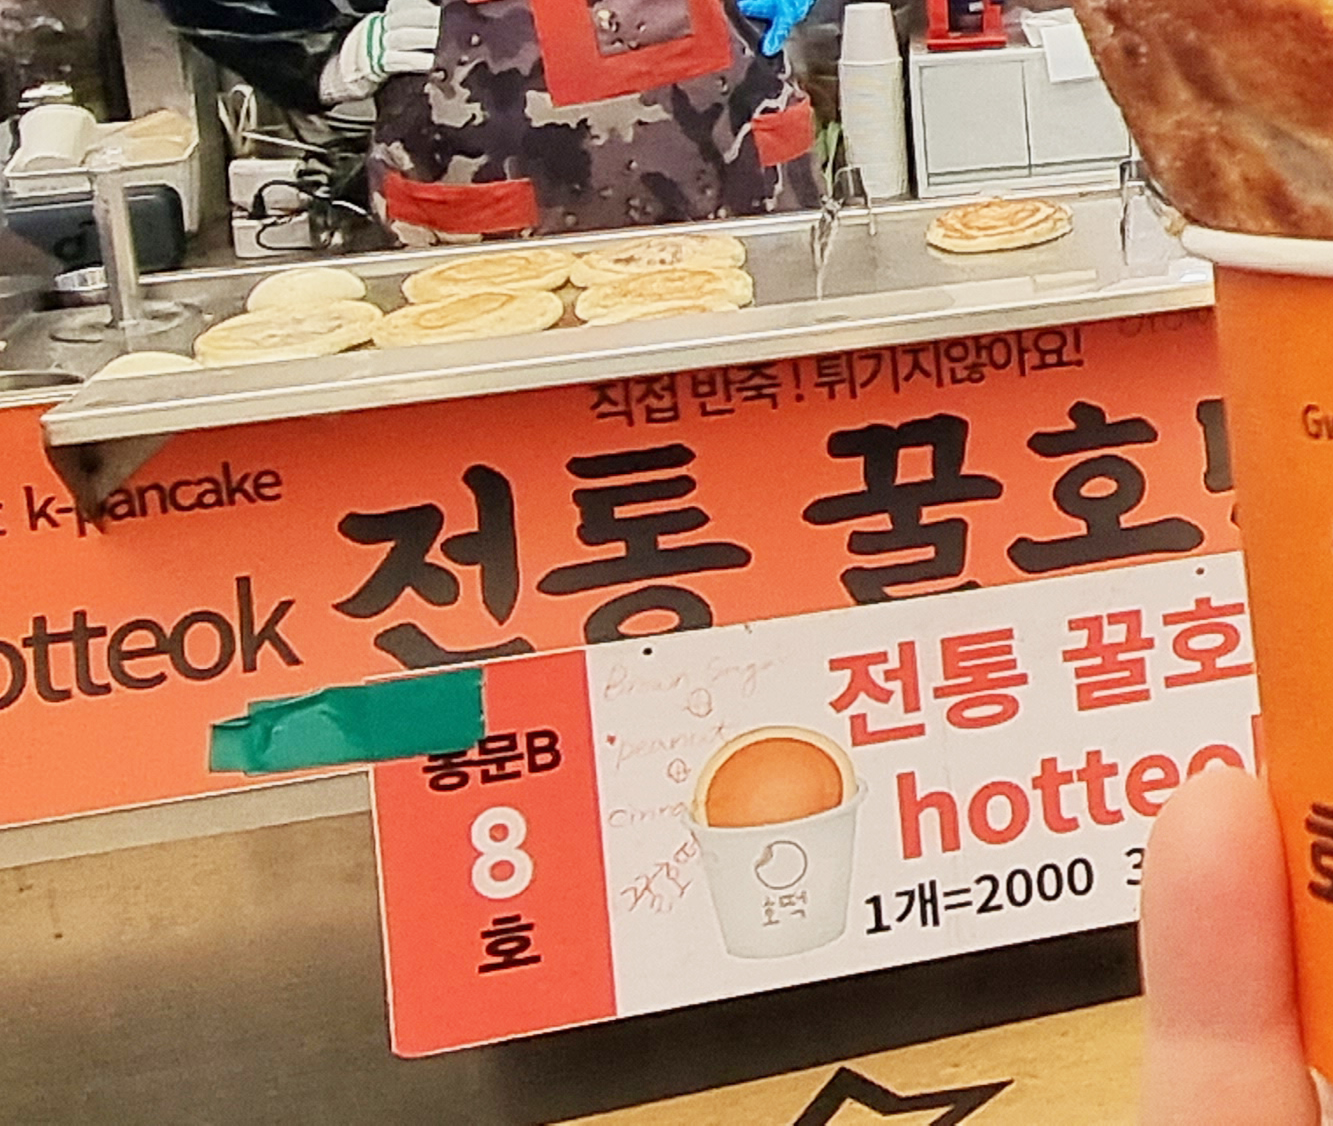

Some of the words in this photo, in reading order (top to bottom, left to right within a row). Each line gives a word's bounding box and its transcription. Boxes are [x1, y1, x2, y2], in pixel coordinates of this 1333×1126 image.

[590, 372, 679, 427] 직접
[690, 361, 782, 417] 반죽
[814, 326, 1085, 400] 튀기지않아요!
[331, 443, 752, 671] 전통
[802, 398, 1240, 605] 꿀호
[828, 627, 1029, 748] 전통
[896, 714, 1262, 860] hotte
[471, 805, 534, 900] 8
[864, 857, 1095, 935] 1개=2000
[477, 913, 542, 974] 호
